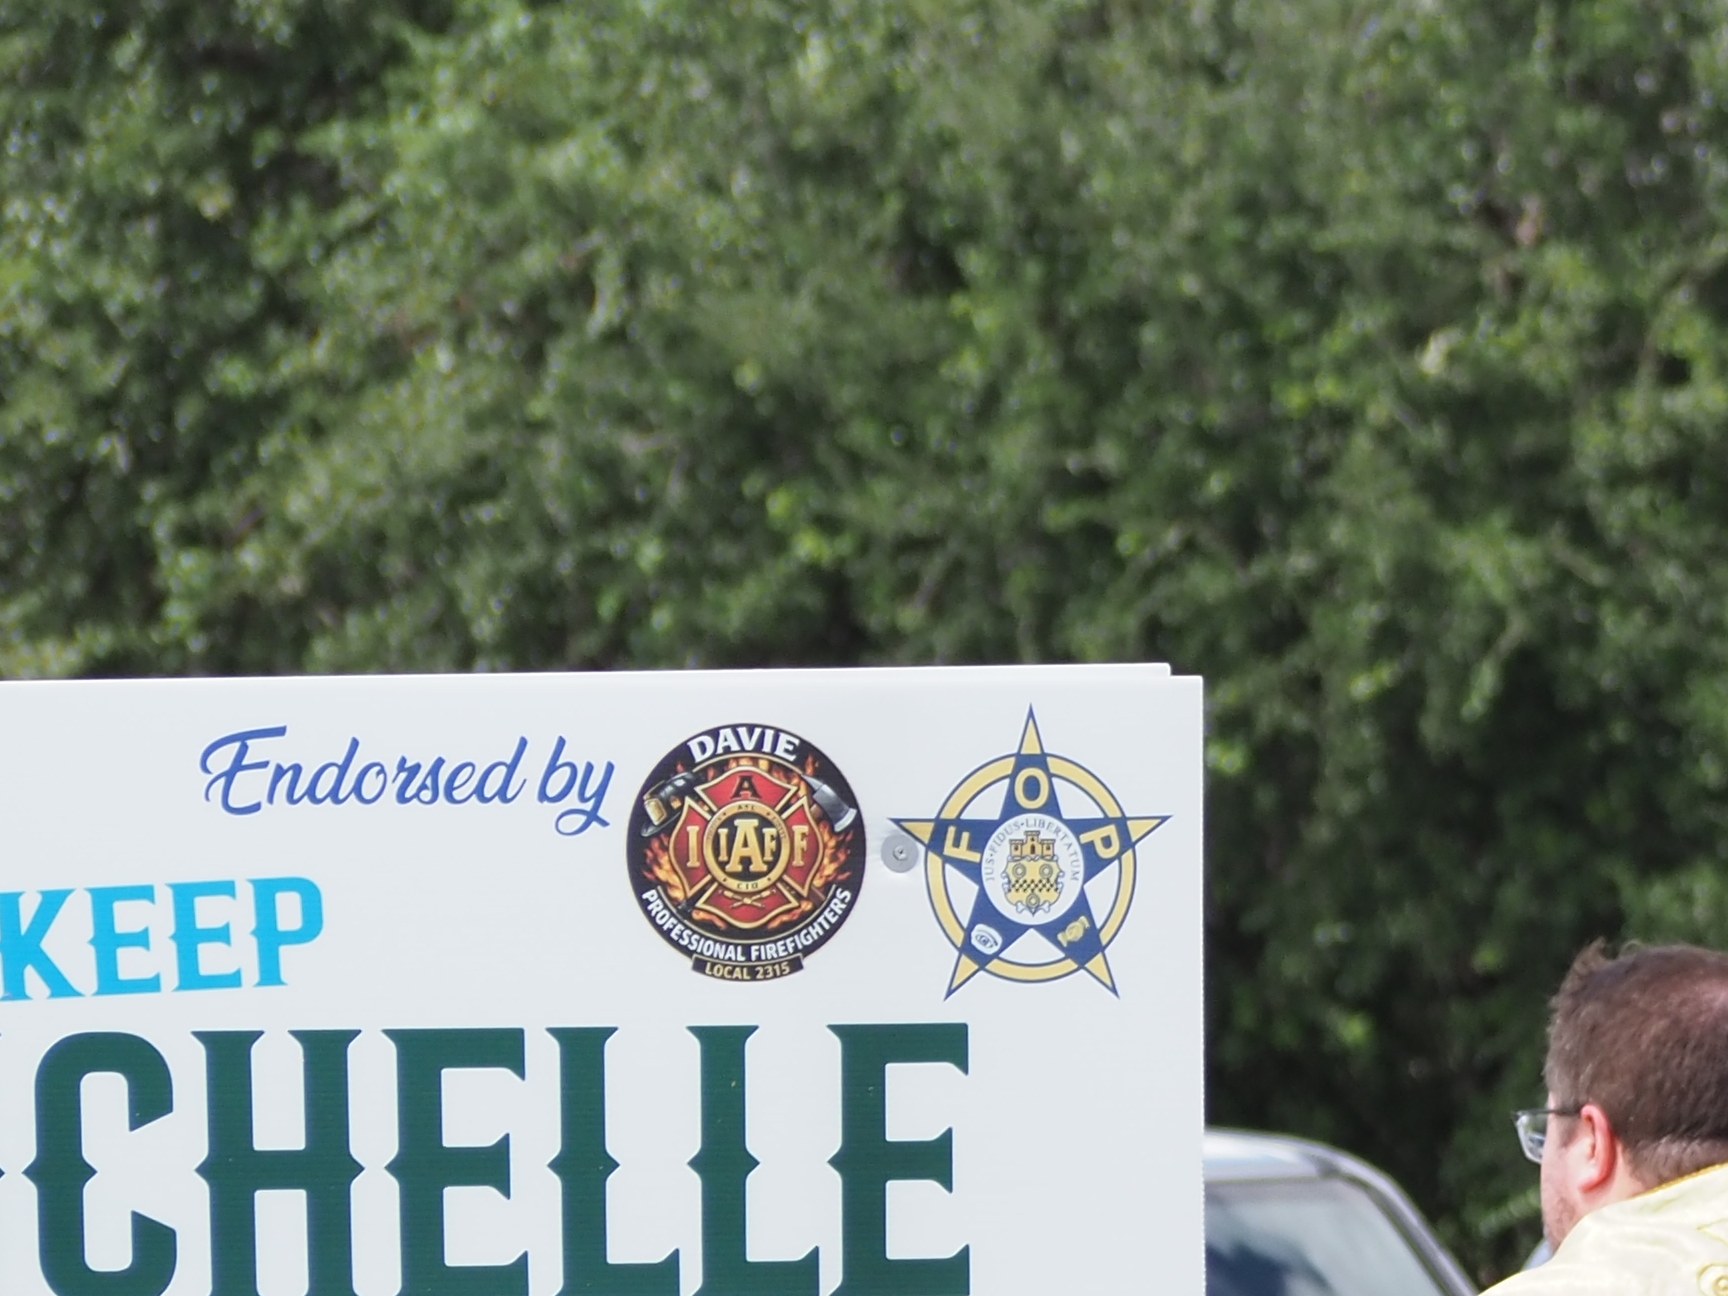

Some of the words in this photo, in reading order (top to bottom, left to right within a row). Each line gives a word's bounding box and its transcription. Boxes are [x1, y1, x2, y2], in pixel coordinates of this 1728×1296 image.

[686, 726, 800, 764] DAVIE
[199, 725, 529, 816] Endorsed
[537, 735, 616, 836] by
[1026, 818, 1081, 882] LIBERTATUM
[0, 876, 325, 1001] KEEP
[641, 888, 746, 962] PROFESSIONAL
[750, 887, 852, 962] FIREFIGHTERS
[704, 962, 751, 980] LOCAL
[755, 962, 791, 980] 2315
